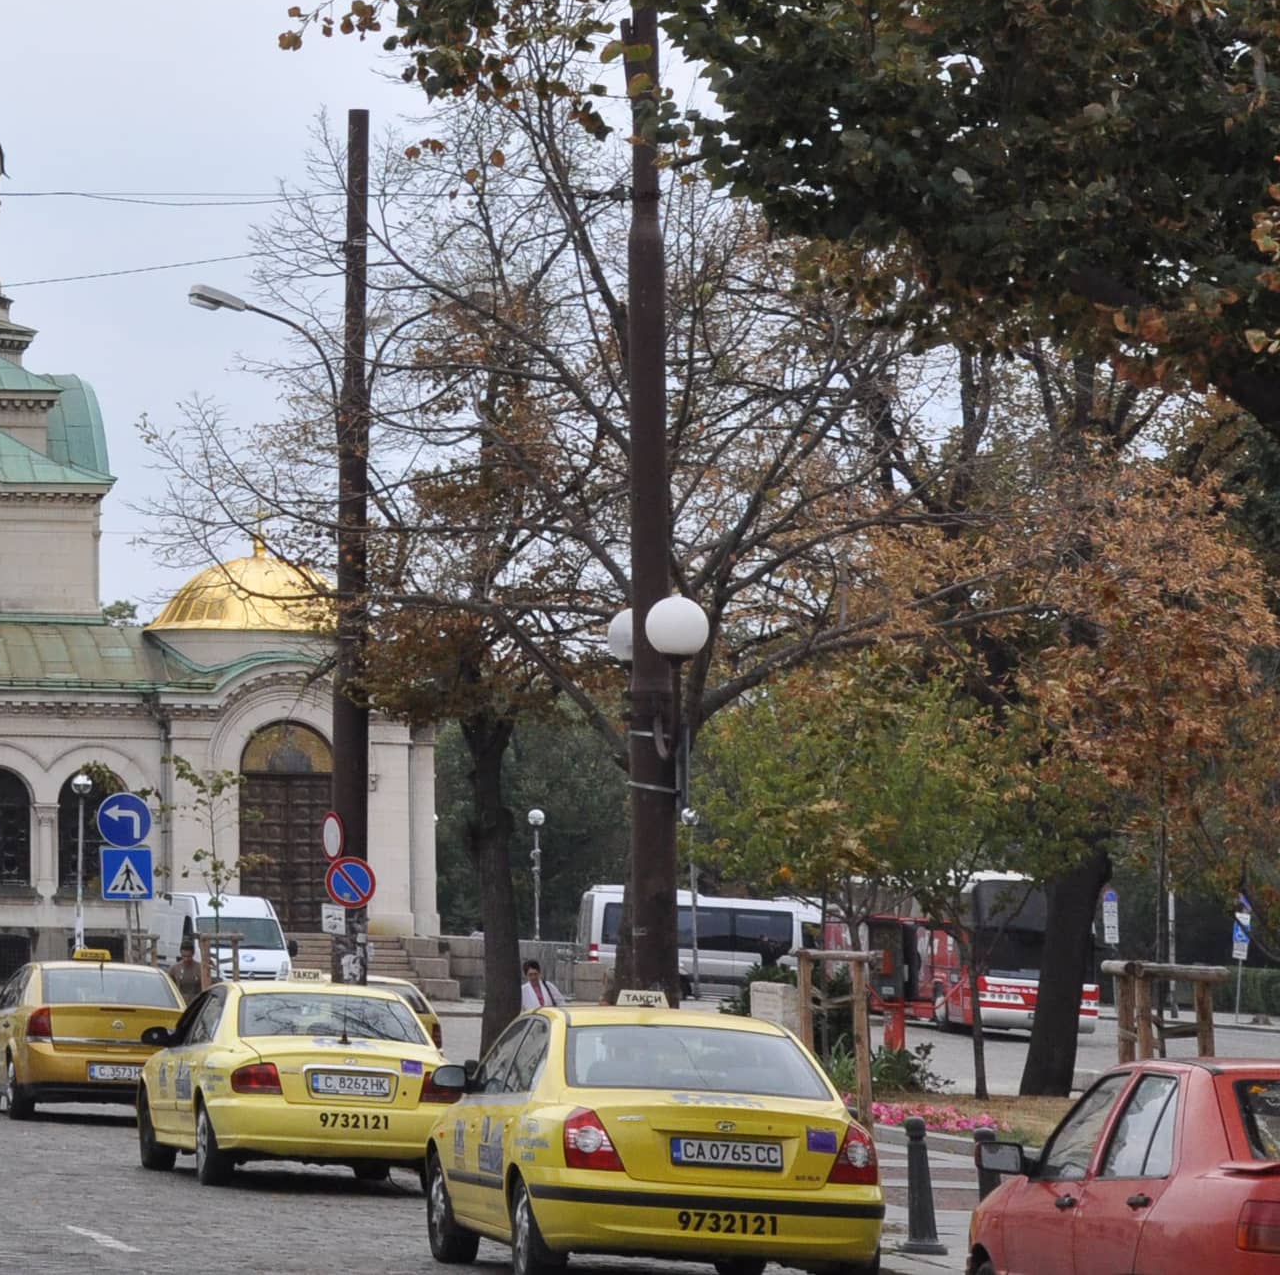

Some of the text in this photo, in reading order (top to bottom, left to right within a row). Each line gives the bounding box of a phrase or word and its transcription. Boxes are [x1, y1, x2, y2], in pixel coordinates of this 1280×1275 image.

[292, 970, 320, 980] ТАКСИ
[624, 993, 662, 1003] ТАКСИ
[324, 1076, 387, 1092] C 8262 HK
[319, 1112, 389, 1130] 9732121
[683, 1141, 778, 1164] CA 0765 CC
[677, 1210, 778, 1236] 9732121
